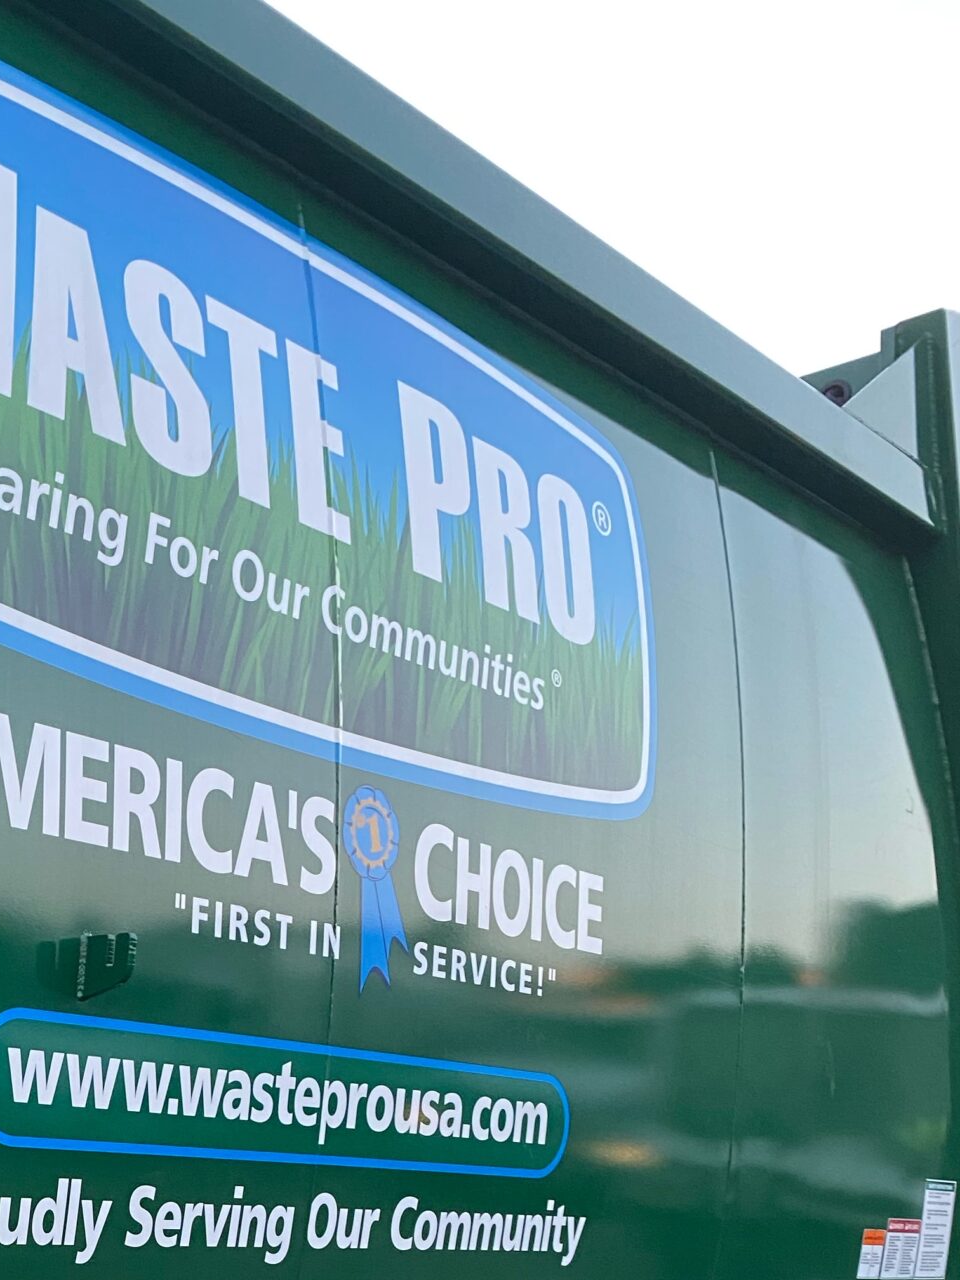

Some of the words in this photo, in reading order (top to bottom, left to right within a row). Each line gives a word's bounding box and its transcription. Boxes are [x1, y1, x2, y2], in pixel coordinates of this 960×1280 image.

[143, 511, 220, 585] For
[231, 548, 311, 620] Our
[413, 823, 605, 956] CHOICE
[173, 891, 295, 950] "FIRST
[309, 920, 341, 960] IN
[412, 940, 558, 997] SERVICE!"
[6, 1046, 549, 1146] www.wasteprousa.com
[123, 1185, 296, 1266] Serving
[306, 1192, 381, 1250] Our
[390, 1196, 587, 1267] Community
